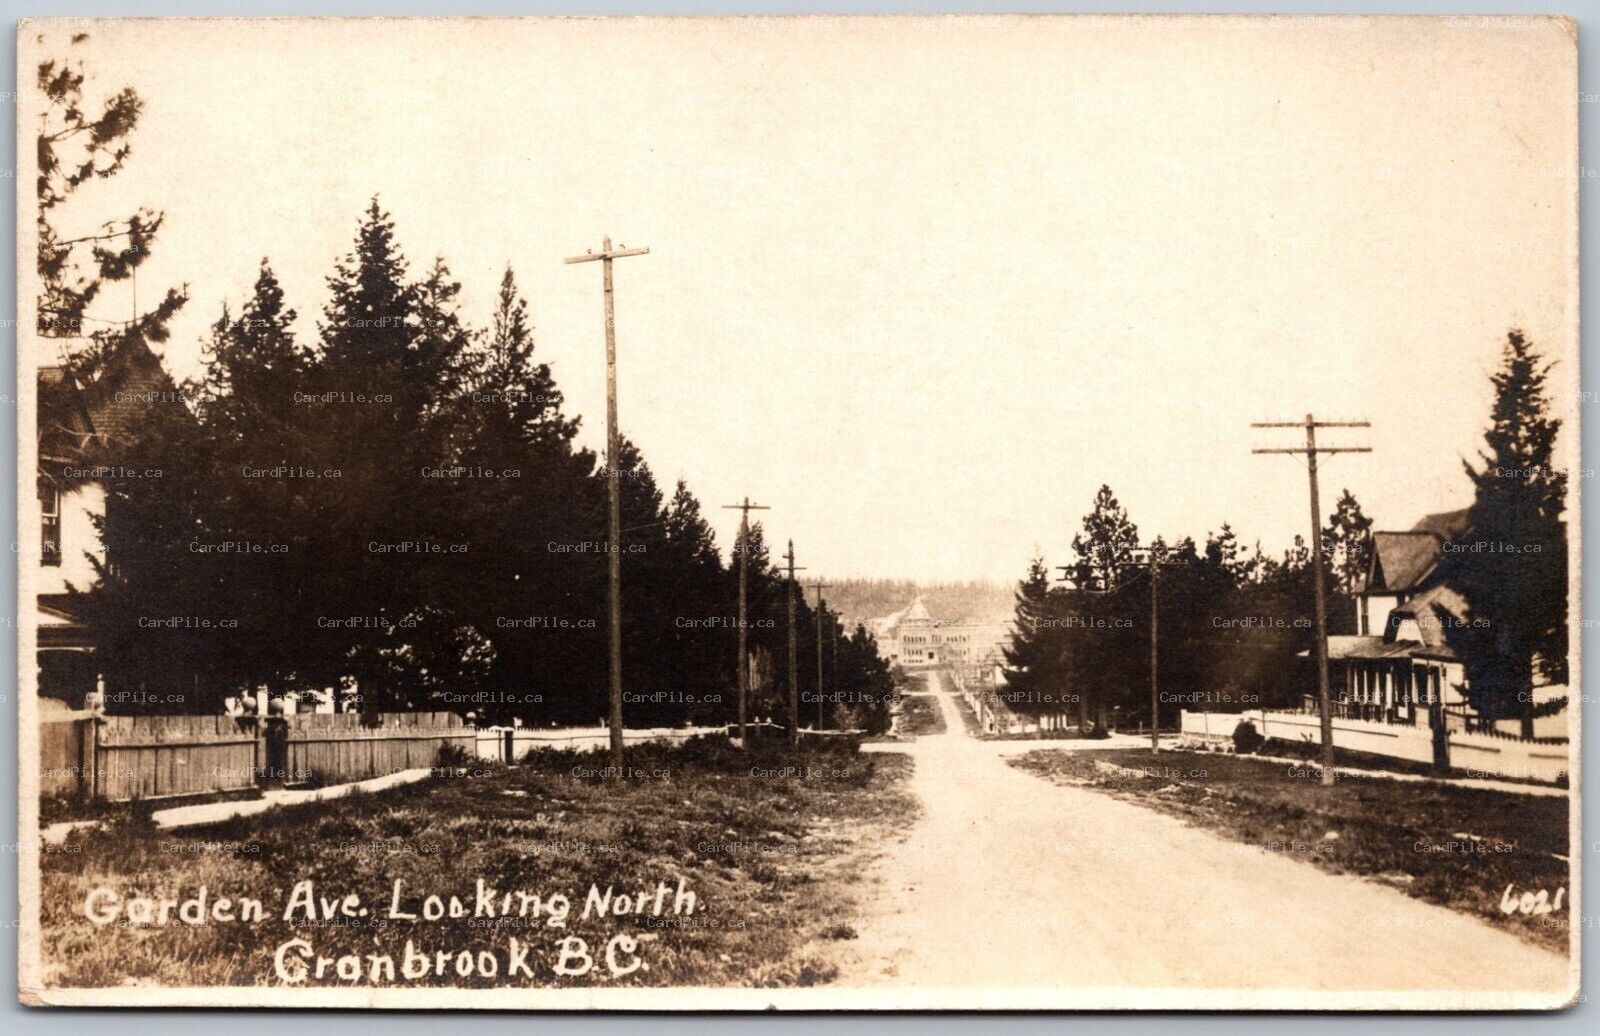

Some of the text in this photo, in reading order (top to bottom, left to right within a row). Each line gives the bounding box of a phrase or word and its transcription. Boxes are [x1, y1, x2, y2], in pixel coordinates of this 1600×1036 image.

[84, 885, 271, 926] Garden
[283, 880, 368, 921] Ave.
[389, 878, 571, 928] Looking
[1500, 883, 1566, 914] 6021
